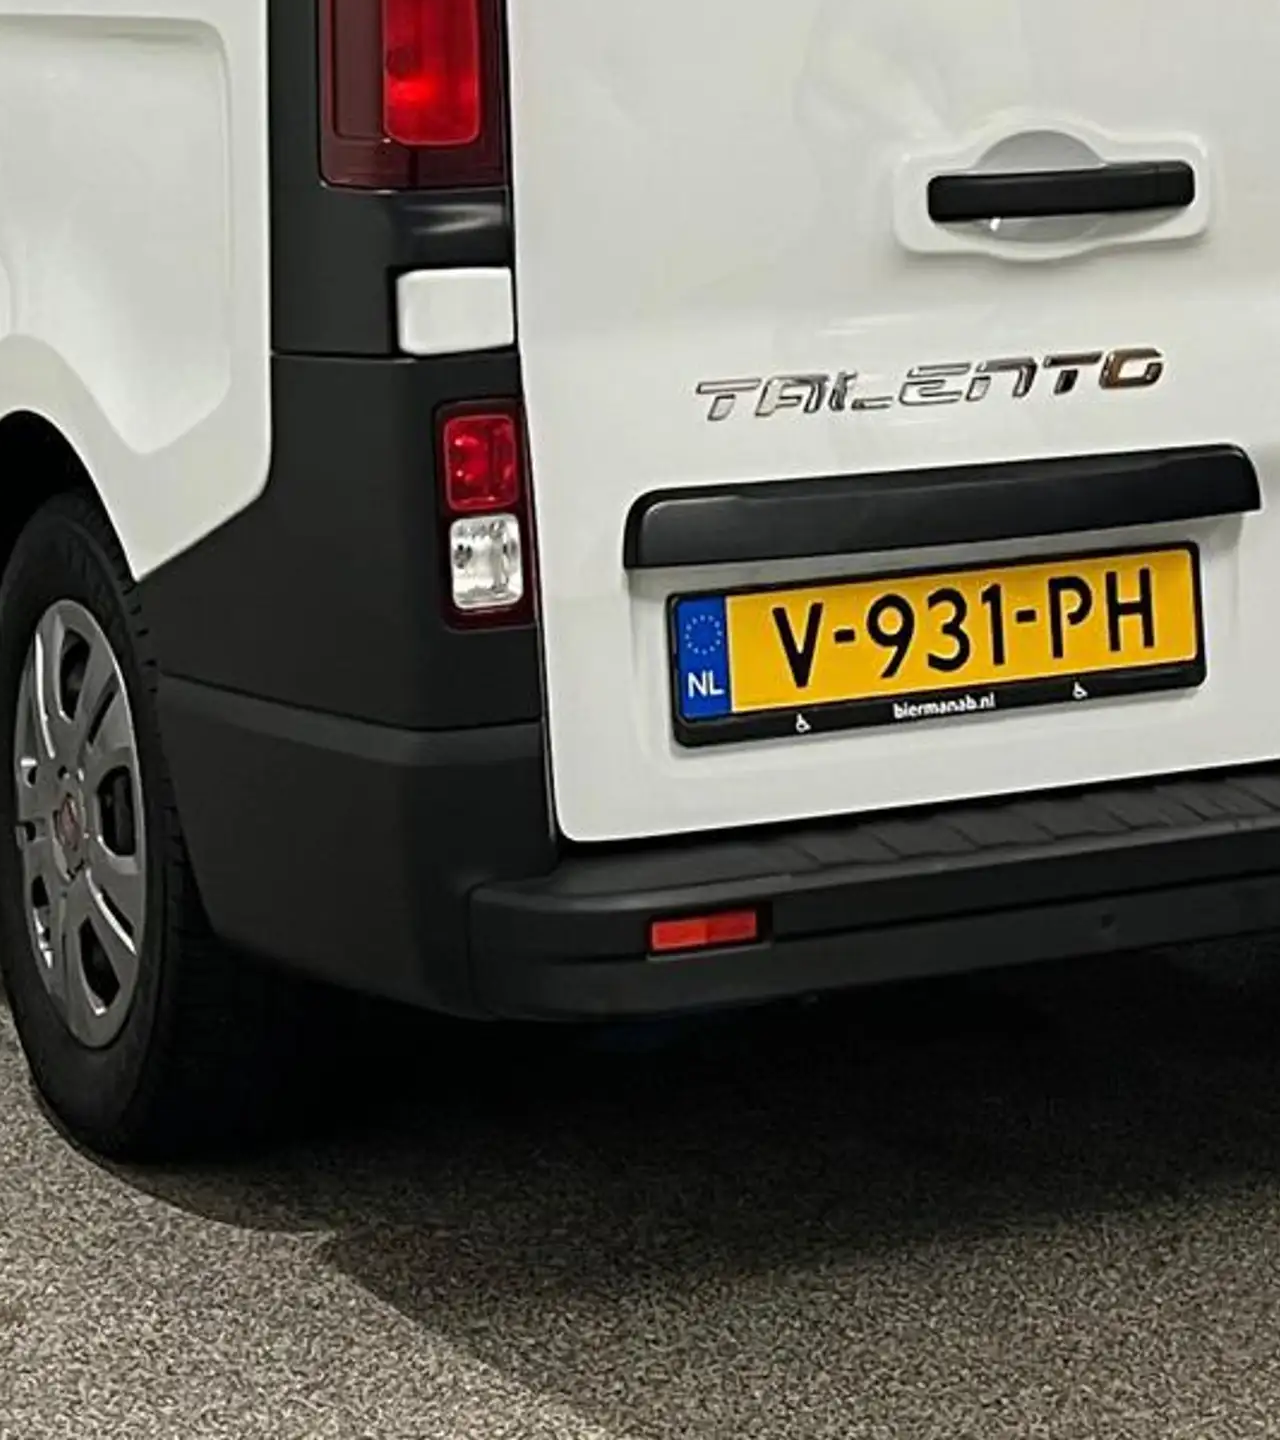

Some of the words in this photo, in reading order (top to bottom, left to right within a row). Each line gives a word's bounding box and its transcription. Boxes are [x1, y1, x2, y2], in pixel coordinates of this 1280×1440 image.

[695, 348, 1164, 421] TALENTO
[771, 568, 1156, 689] V-931-PH
[688, 671, 724, 699] NL
[893, 692, 996, 719] biermanab.nl
